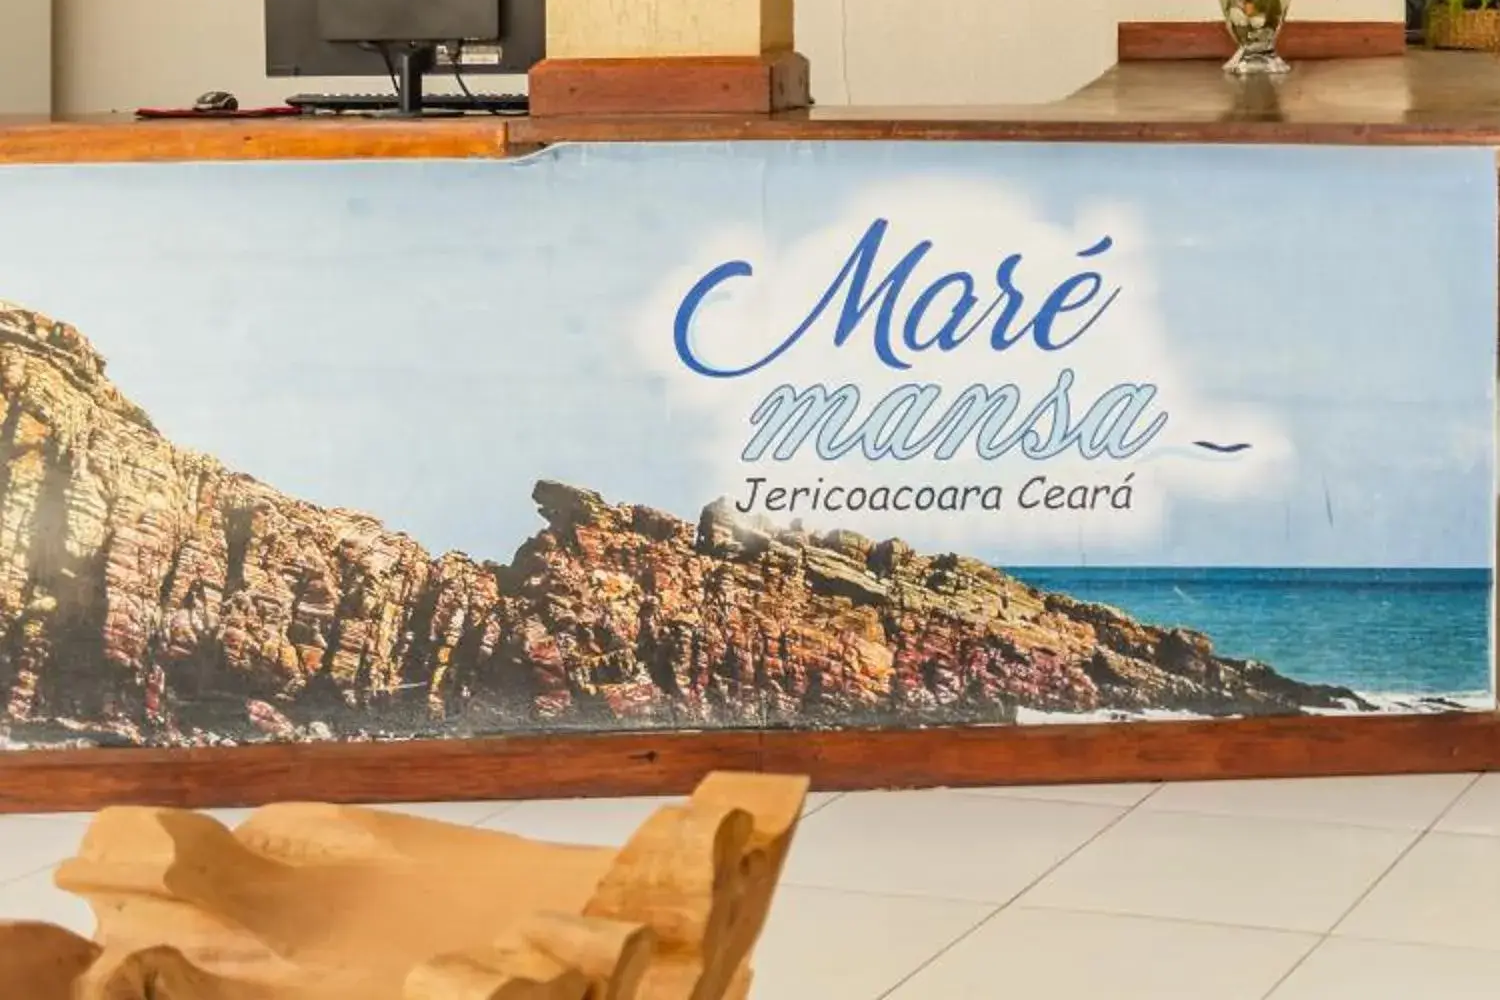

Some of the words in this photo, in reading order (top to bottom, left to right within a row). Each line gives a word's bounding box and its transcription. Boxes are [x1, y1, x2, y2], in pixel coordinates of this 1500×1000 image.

[674, 218, 1121, 377] Maré
[742, 368, 1168, 461] mansa
[736, 477, 1001, 512] Jericoacoara
[1017, 472, 1135, 509] Ceará
